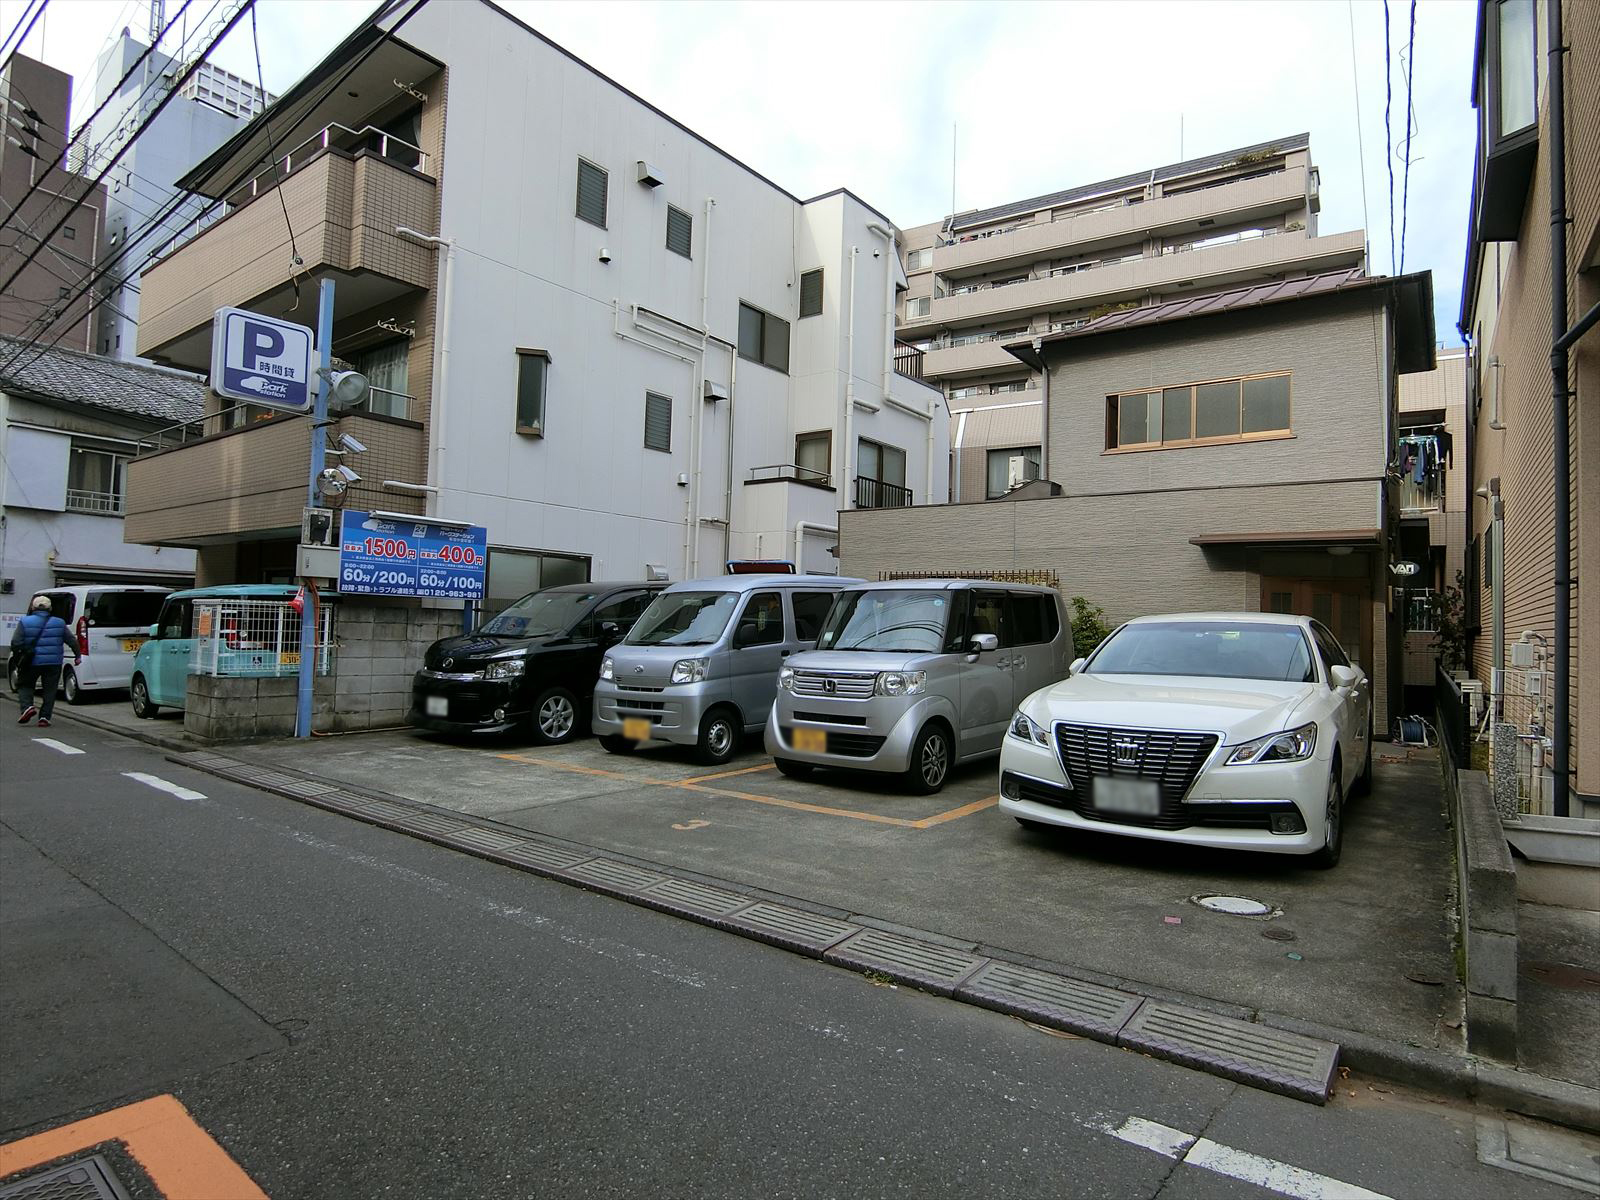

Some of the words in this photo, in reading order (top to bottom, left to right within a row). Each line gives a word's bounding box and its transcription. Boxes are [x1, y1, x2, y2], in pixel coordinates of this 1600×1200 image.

[243, 321, 285, 370] P
[260, 361, 294, 378] 時間貸
[260, 389, 286, 398] station
[364, 536, 416, 559] 1500円
[438, 545, 483, 565] 400円
